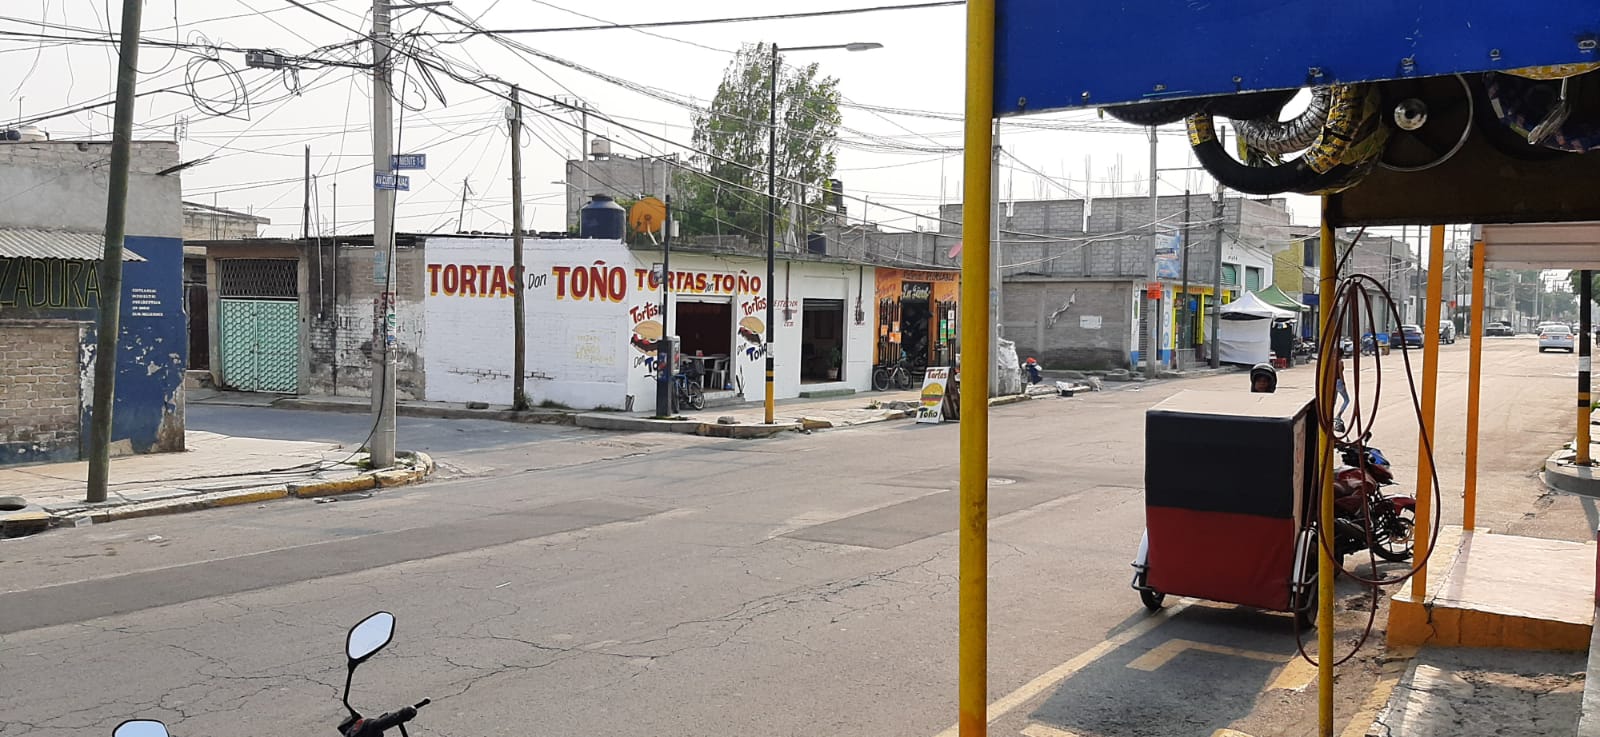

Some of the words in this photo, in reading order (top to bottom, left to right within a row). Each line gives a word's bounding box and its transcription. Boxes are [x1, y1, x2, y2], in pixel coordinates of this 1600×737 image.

[528, 273, 547, 290] Don
[552, 260, 627, 303] TOÑO
[634, 268, 707, 293] TORTAS
[712, 269, 762, 295] TOÑO
[742, 296, 767, 316] Tortas
[644, 356, 659, 373] To
